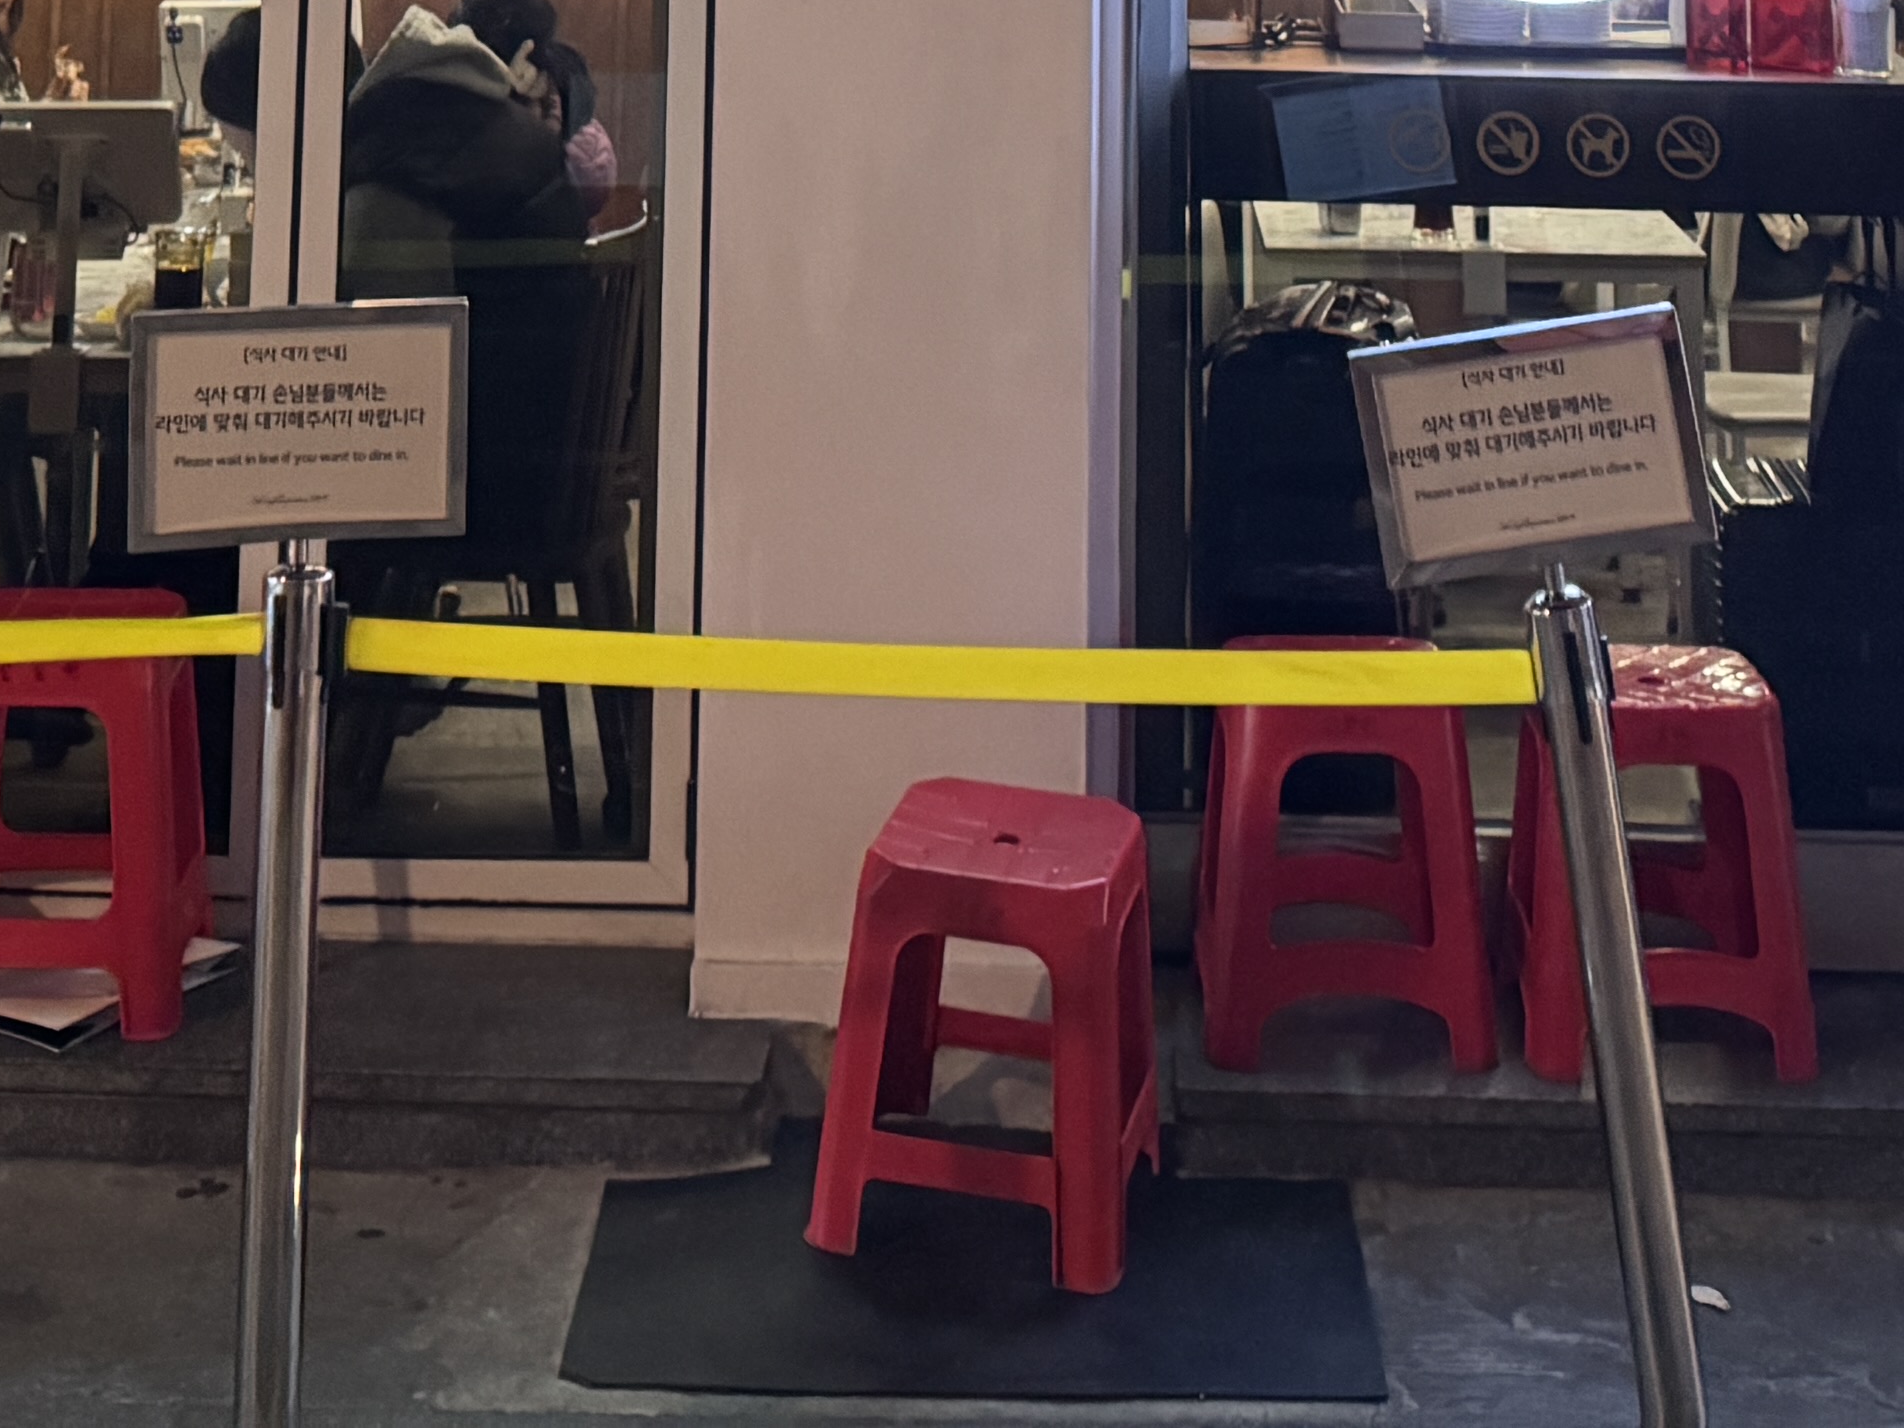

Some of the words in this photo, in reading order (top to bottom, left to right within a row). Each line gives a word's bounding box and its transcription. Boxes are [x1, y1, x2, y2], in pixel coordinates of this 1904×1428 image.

[280, 345, 309, 363] 대기
[1497, 363, 1527, 383] 대기
[194, 384, 229, 407] 식사
[232, 383, 267, 404] 대기
[272, 380, 388, 404] 손님분들께서는
[154, 413, 208, 434] 라인에
[213, 411, 248, 433] 맞춰
[254, 408, 353, 430] 대기해주시기
[358, 406, 425, 428] 바랍니다
[1421, 414, 1456, 437] 식사
[1459, 407, 1494, 430] 대기
[1497, 391, 1614, 427] 손님분들께서는
[1445, 437, 1481, 460] 맞춰
[1484, 423, 1584, 453] 대기해주시기
[1588, 413, 1657, 439] 바랍니다
[173, 454, 214, 468] Please
[216, 453, 243, 466] wait
[293, 453, 317, 466] you
[319, 450, 350, 463] want
[353, 451, 367, 463] to
[368, 449, 393, 462] dine
[1414, 486, 1454, 503] Please
[1455, 480, 1483, 495] wait
[1520, 472, 1530, 487] if
[1531, 471, 1556, 489] you
[1557, 468, 1589, 483] want
[1590, 465, 1605, 478] to
[1606, 461, 1633, 476] dine
